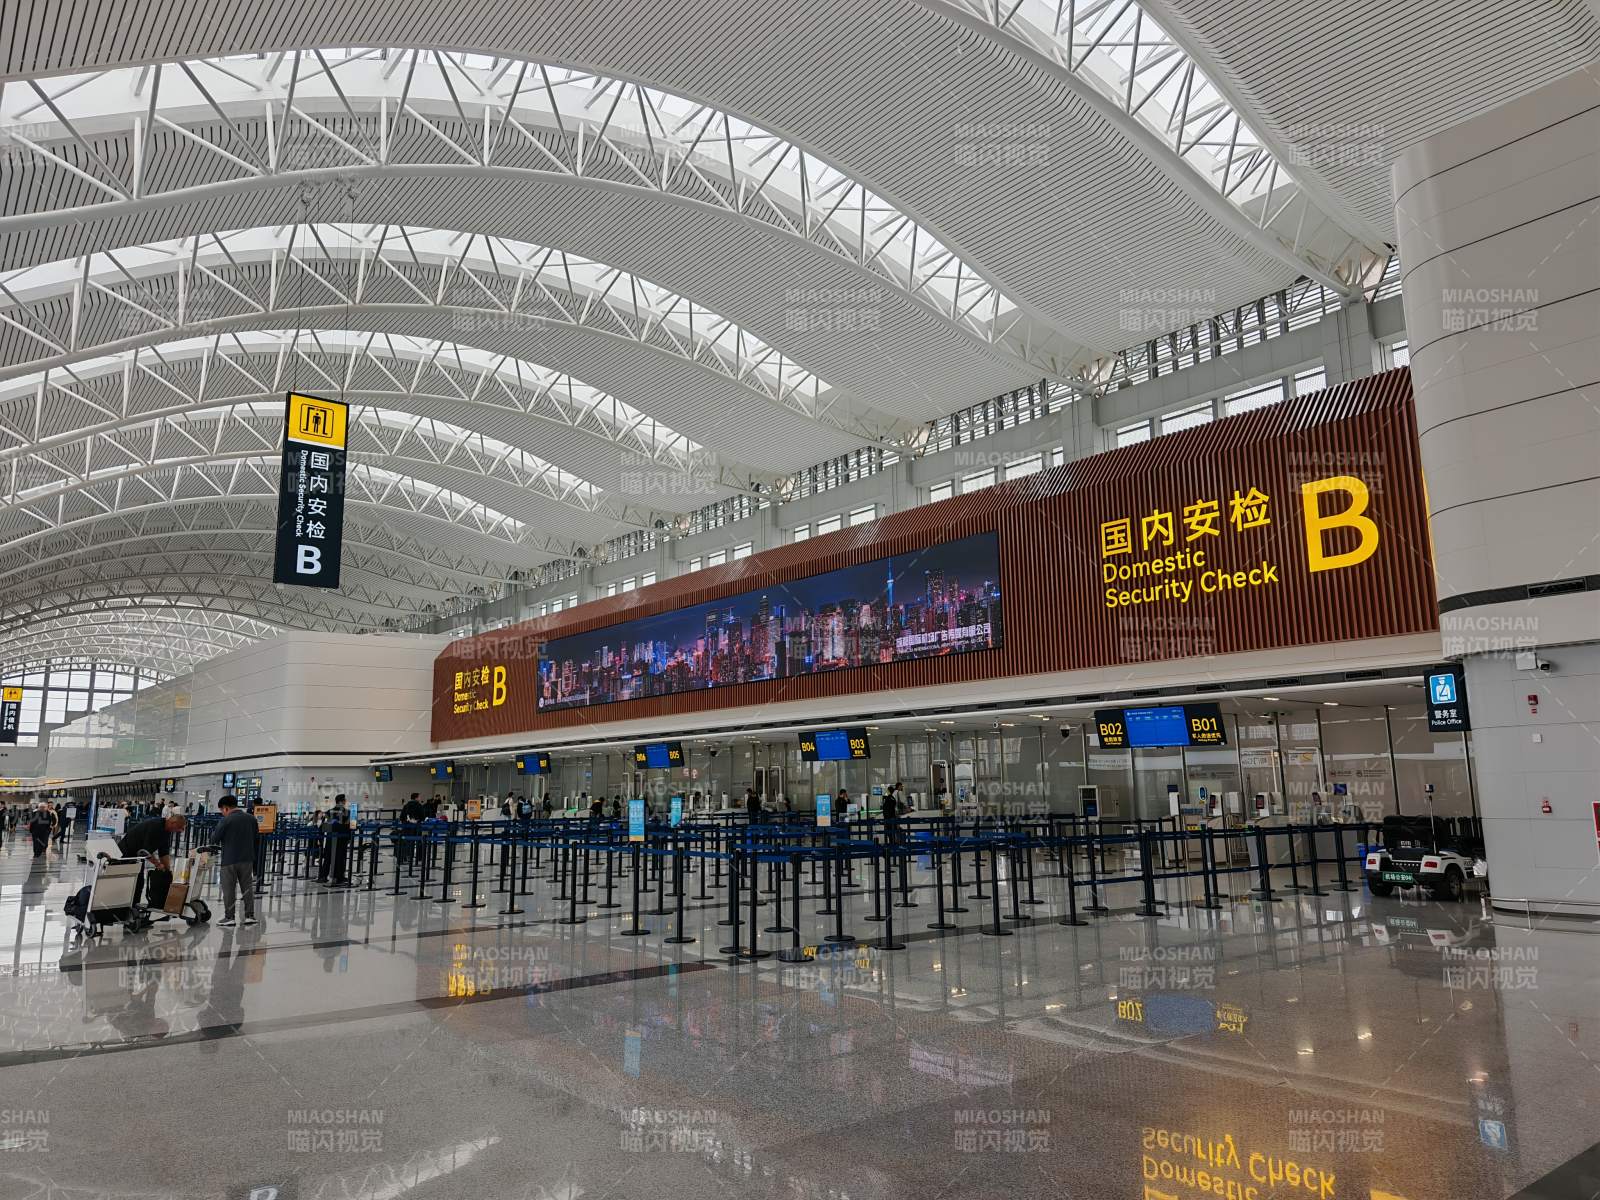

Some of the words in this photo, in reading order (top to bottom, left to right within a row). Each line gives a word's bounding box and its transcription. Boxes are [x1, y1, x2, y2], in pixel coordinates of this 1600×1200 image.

[299, 449, 309, 483] Domestic
[296, 483, 306, 514] Security
[306, 451, 329, 539] 国内安检
[295, 515, 304, 538] Check
[1101, 487, 1271, 560] 国内安检
[1301, 475, 1379, 573] B
[296, 544, 322, 575] B
[1103, 548, 1206, 583] Domestic
[1105, 579, 1193, 608] Security
[1200, 561, 1279, 593] Check
[455, 665, 490, 690] 国内安检
[493, 665, 507, 706] B
[454, 702, 472, 714] Security
[474, 698, 489, 710] Check
[1434, 709, 1458, 718] 警务室
[1100, 722, 1123, 736] B02
[1192, 717, 1218, 731] B01
[669, 751, 680, 760] B05
[801, 742, 815, 752] B04
[850, 739, 865, 749] B03
